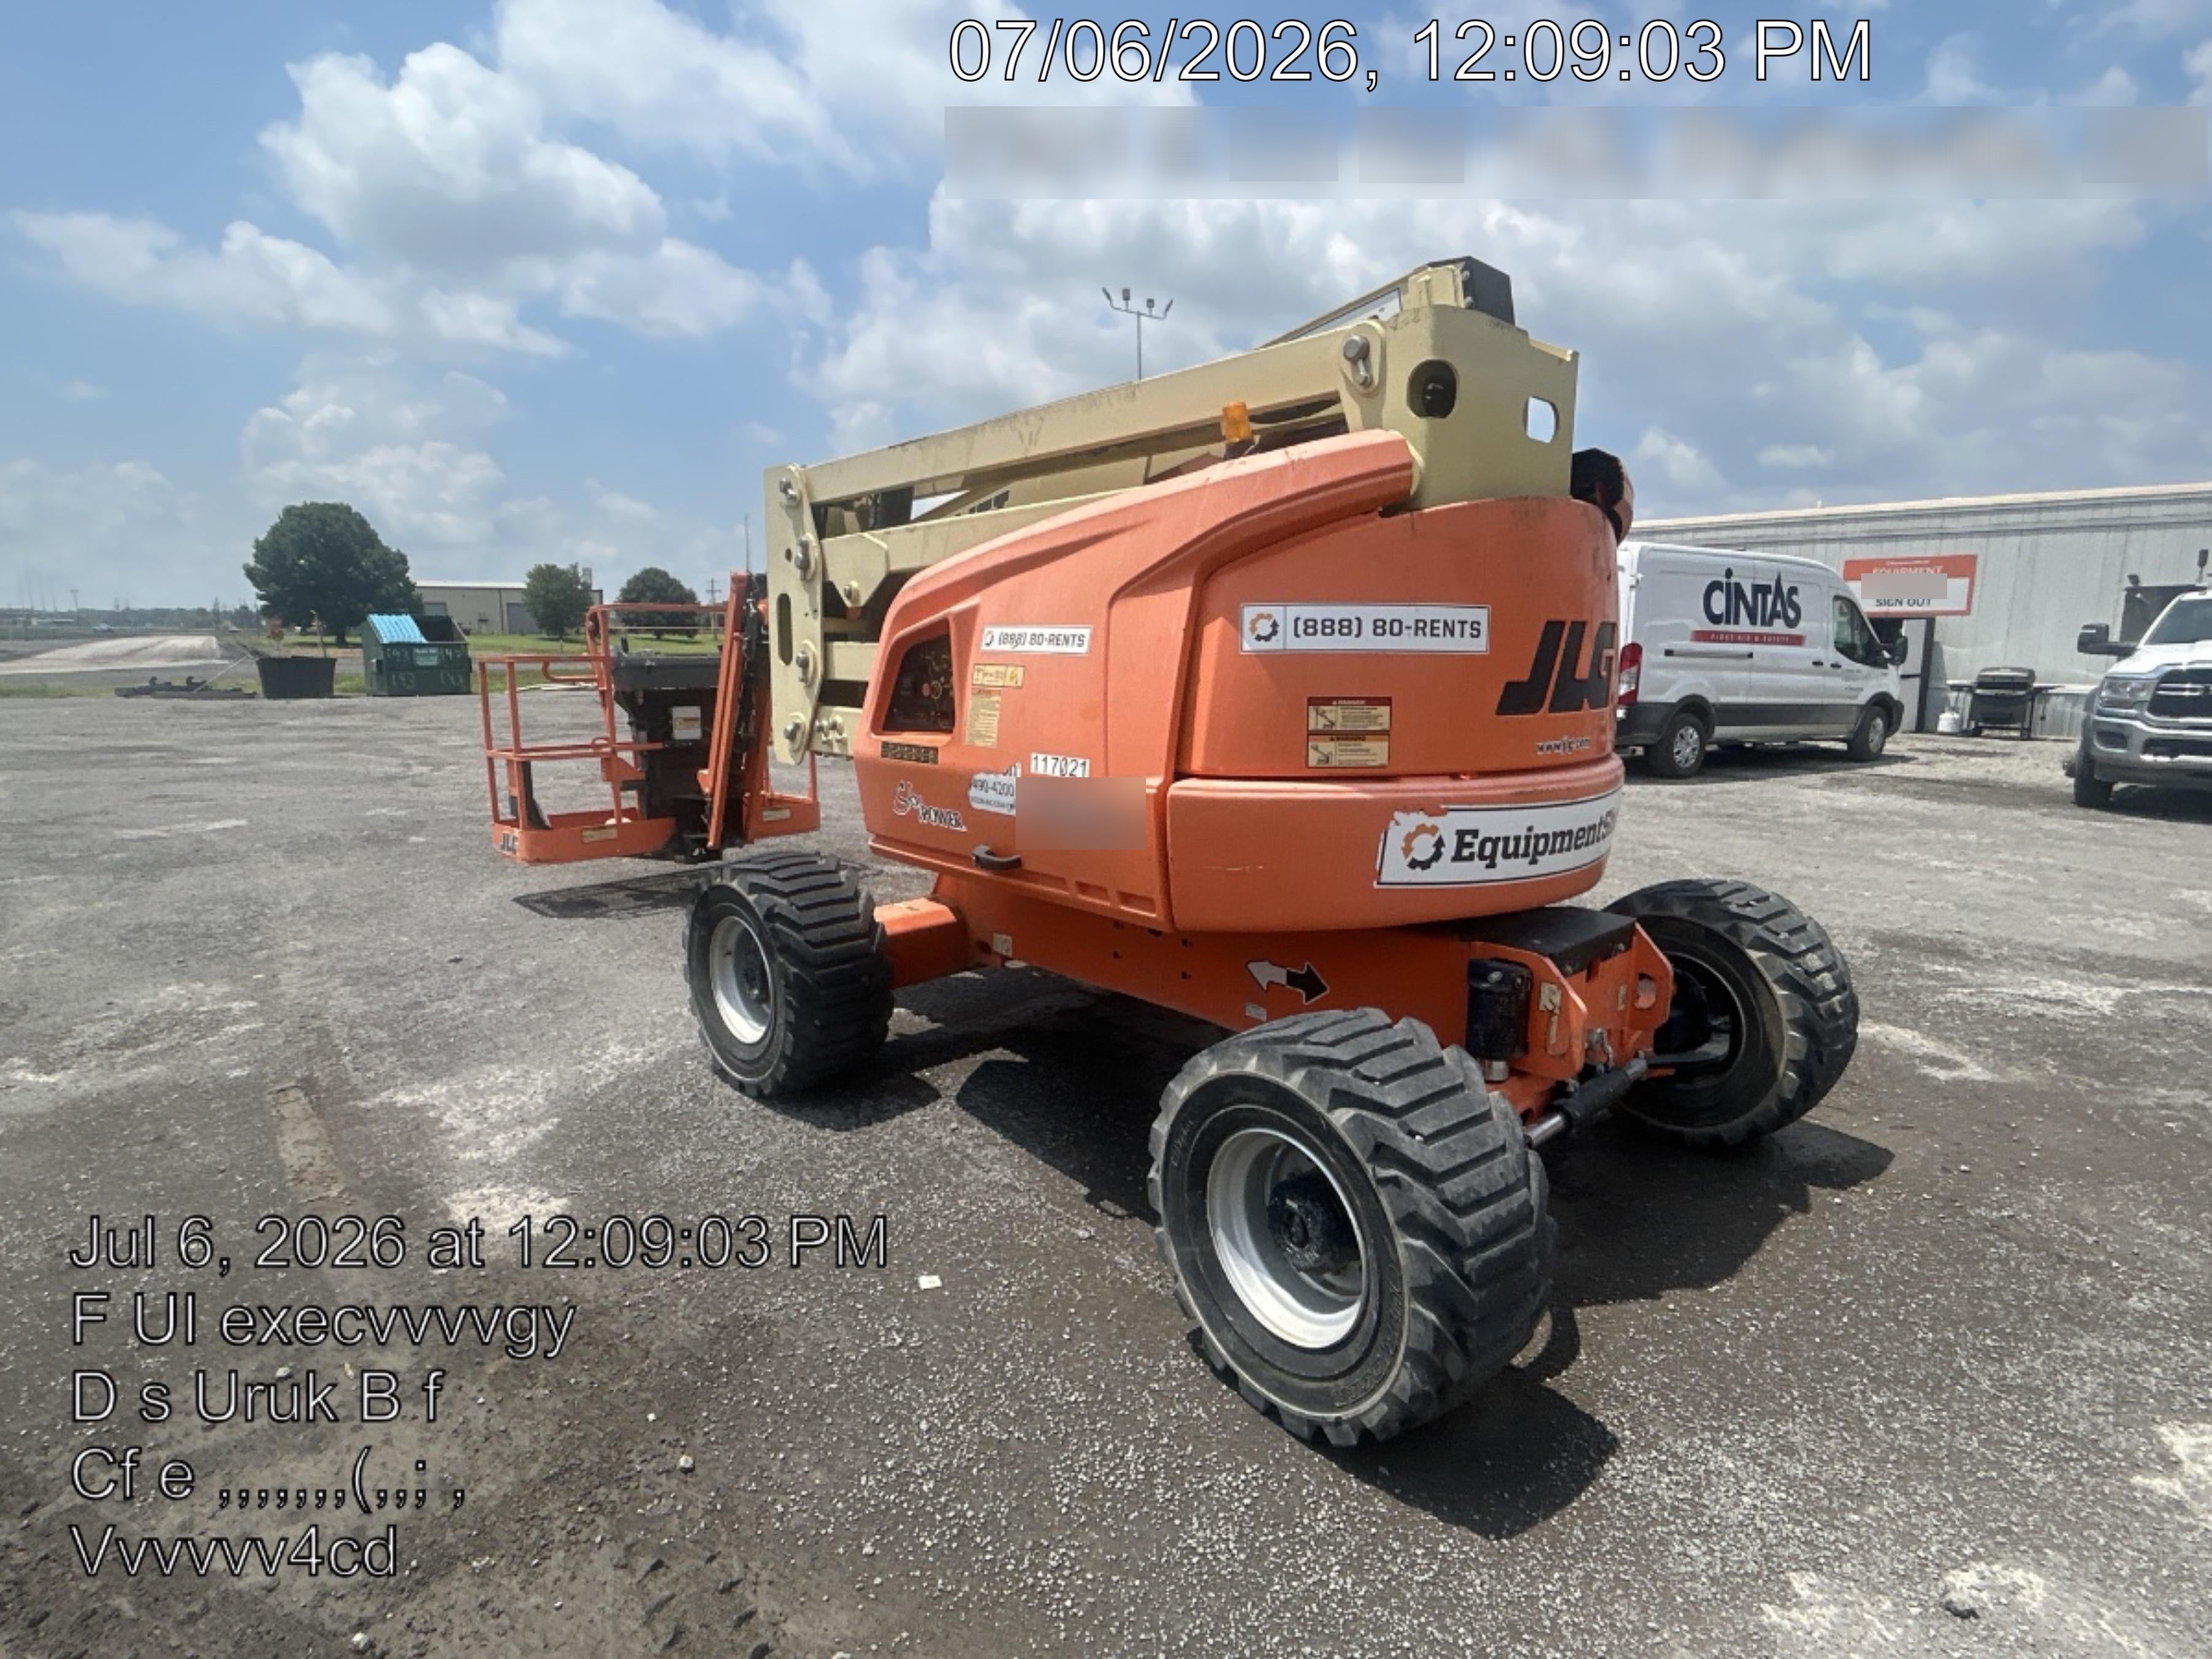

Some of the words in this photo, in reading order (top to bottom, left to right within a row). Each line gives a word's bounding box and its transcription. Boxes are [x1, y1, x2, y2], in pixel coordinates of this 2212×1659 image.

[1293, 617, 1362, 638] (888)
[1373, 618, 1481, 638] 80-RENTS
[1495, 621, 1616, 716] JLG
[1033, 755, 1086, 777] 117021
